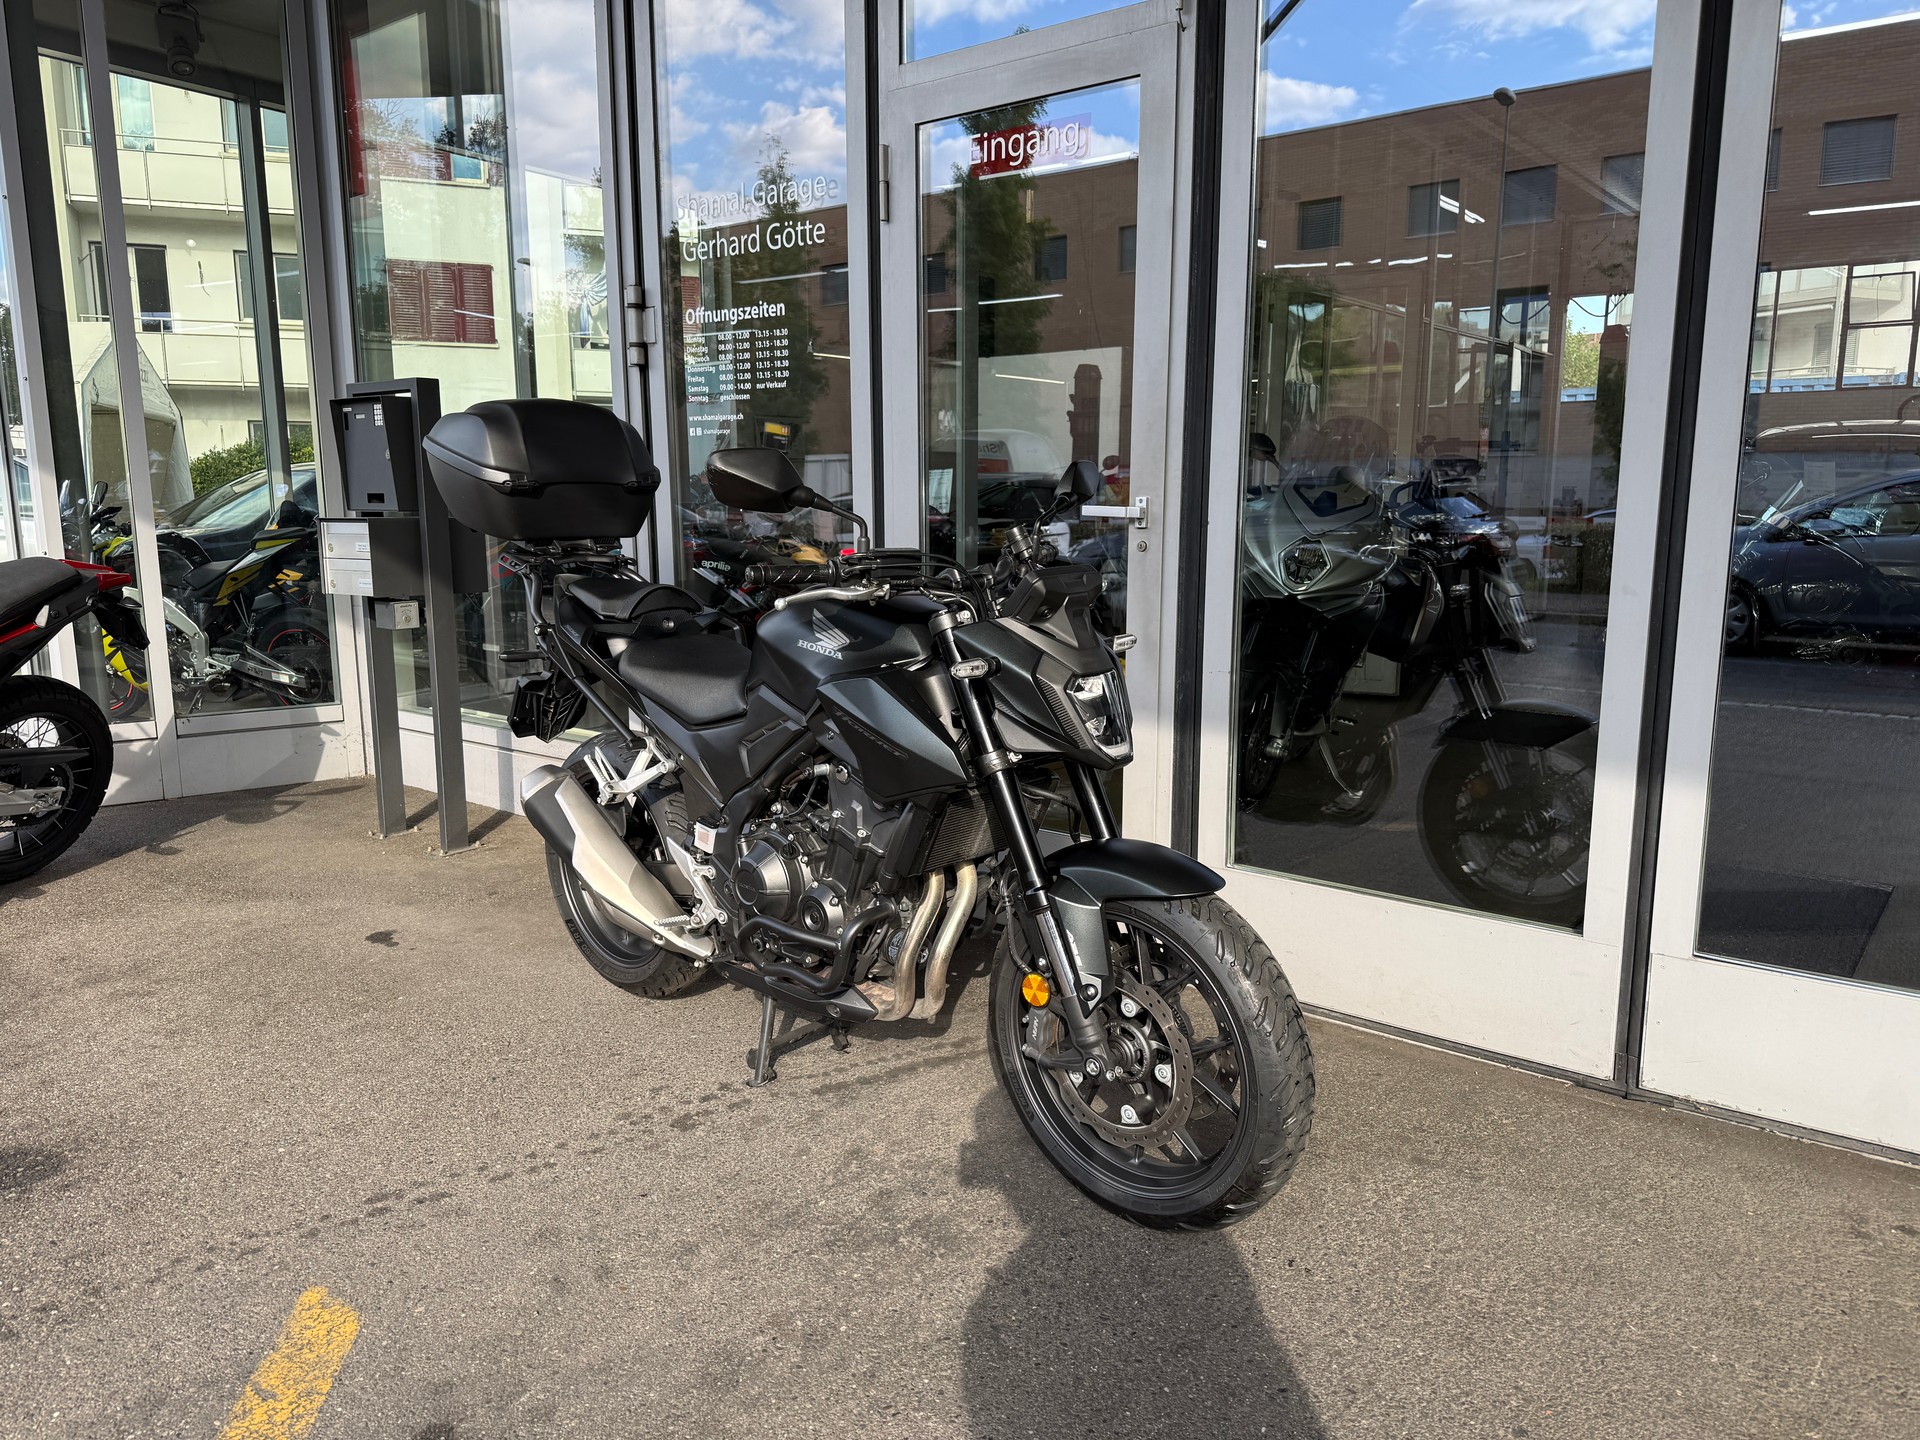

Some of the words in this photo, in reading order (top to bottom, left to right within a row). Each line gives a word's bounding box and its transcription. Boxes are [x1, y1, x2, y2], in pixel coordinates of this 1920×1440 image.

[969, 122, 1080, 166] Eingang
[676, 182, 745, 220] Shamal
[752, 176, 826, 207] Garage
[683, 224, 760, 262] Gerhard
[766, 220, 826, 250] Götte
[720, 393, 750, 402] geschlossen
[689, 413, 744, 421] www.shamalgarage.ch
[701, 560, 731, 571] aprilia
[797, 639, 843, 660] HONDA
